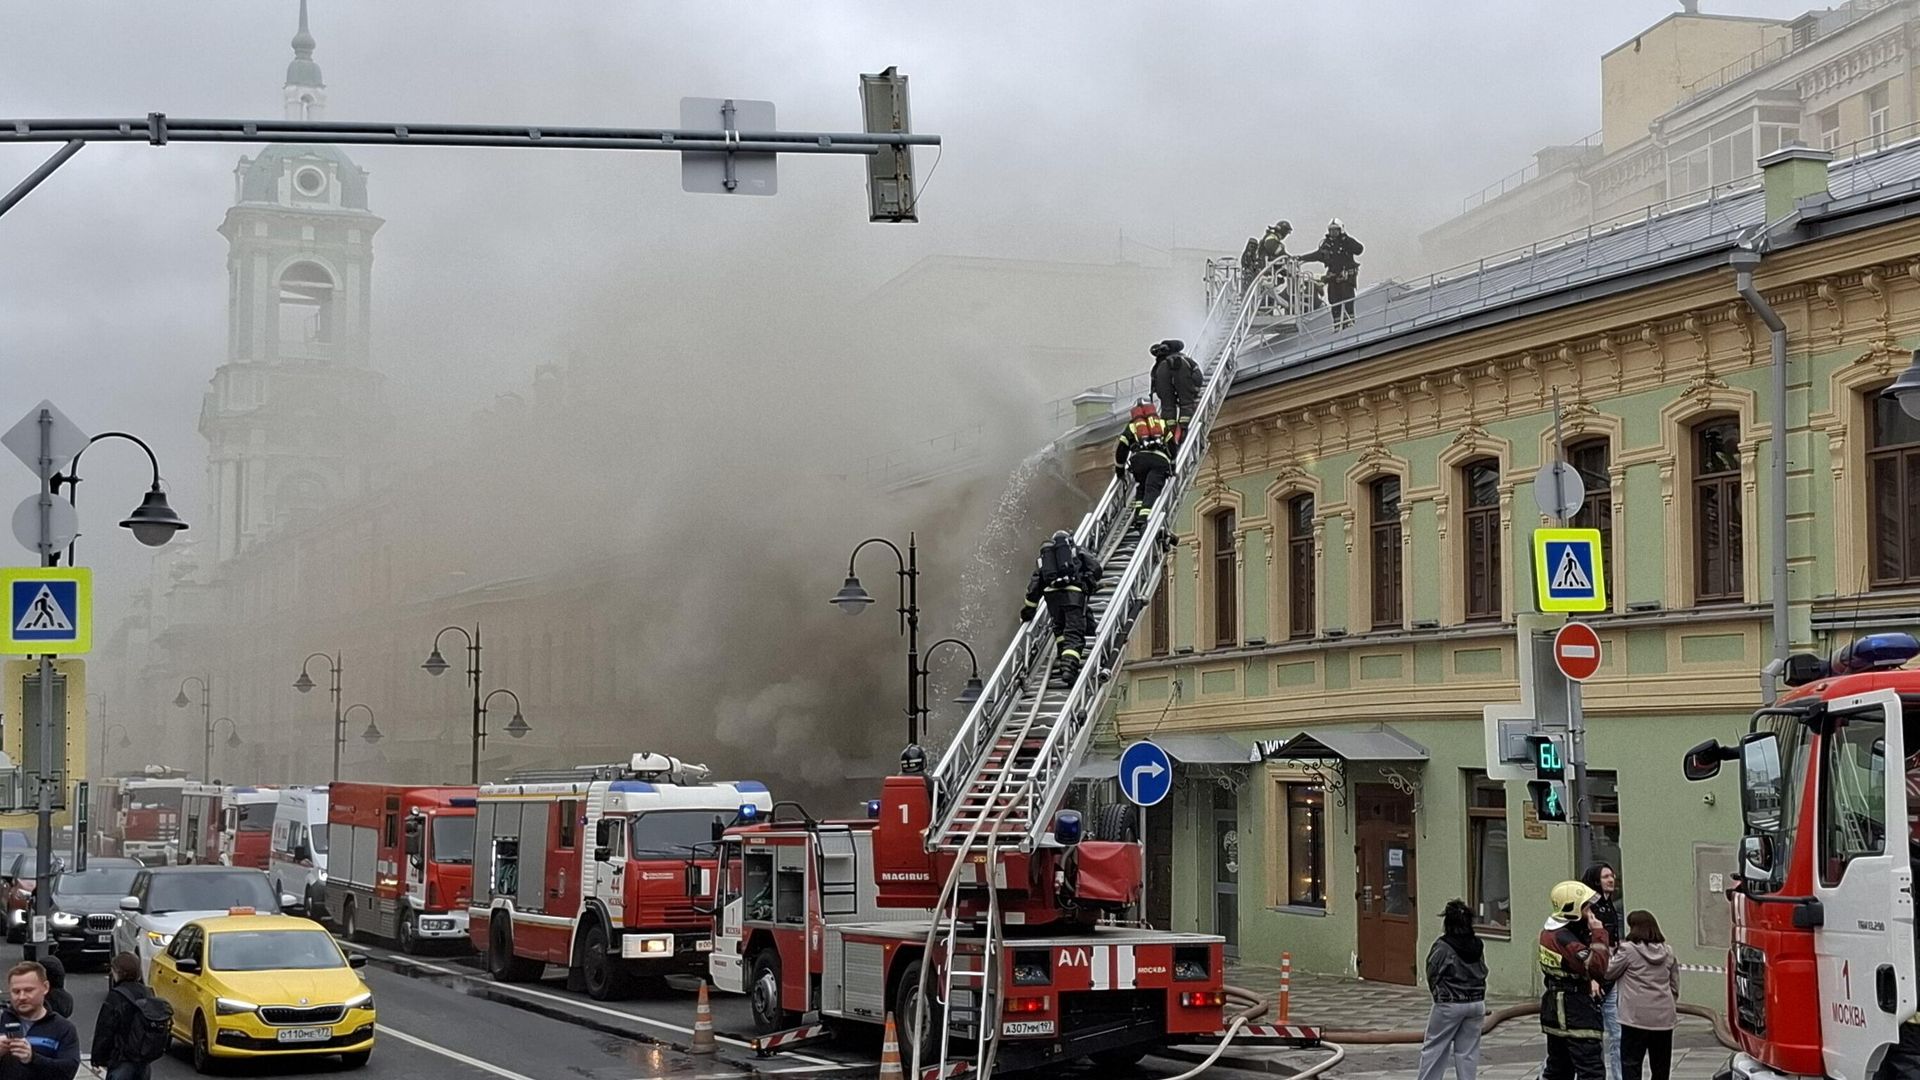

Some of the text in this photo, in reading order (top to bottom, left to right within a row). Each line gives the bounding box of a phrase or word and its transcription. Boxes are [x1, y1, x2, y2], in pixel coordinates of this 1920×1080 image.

[898, 804, 909, 824] 1
[881, 872, 930, 881] MAGIRUS
[1058, 948, 1089, 967] АЛ
[1137, 966, 1167, 974] МОСКВА
[1842, 960, 1850, 1000] 1
[1832, 1002, 1867, 1029] МОСКВА
